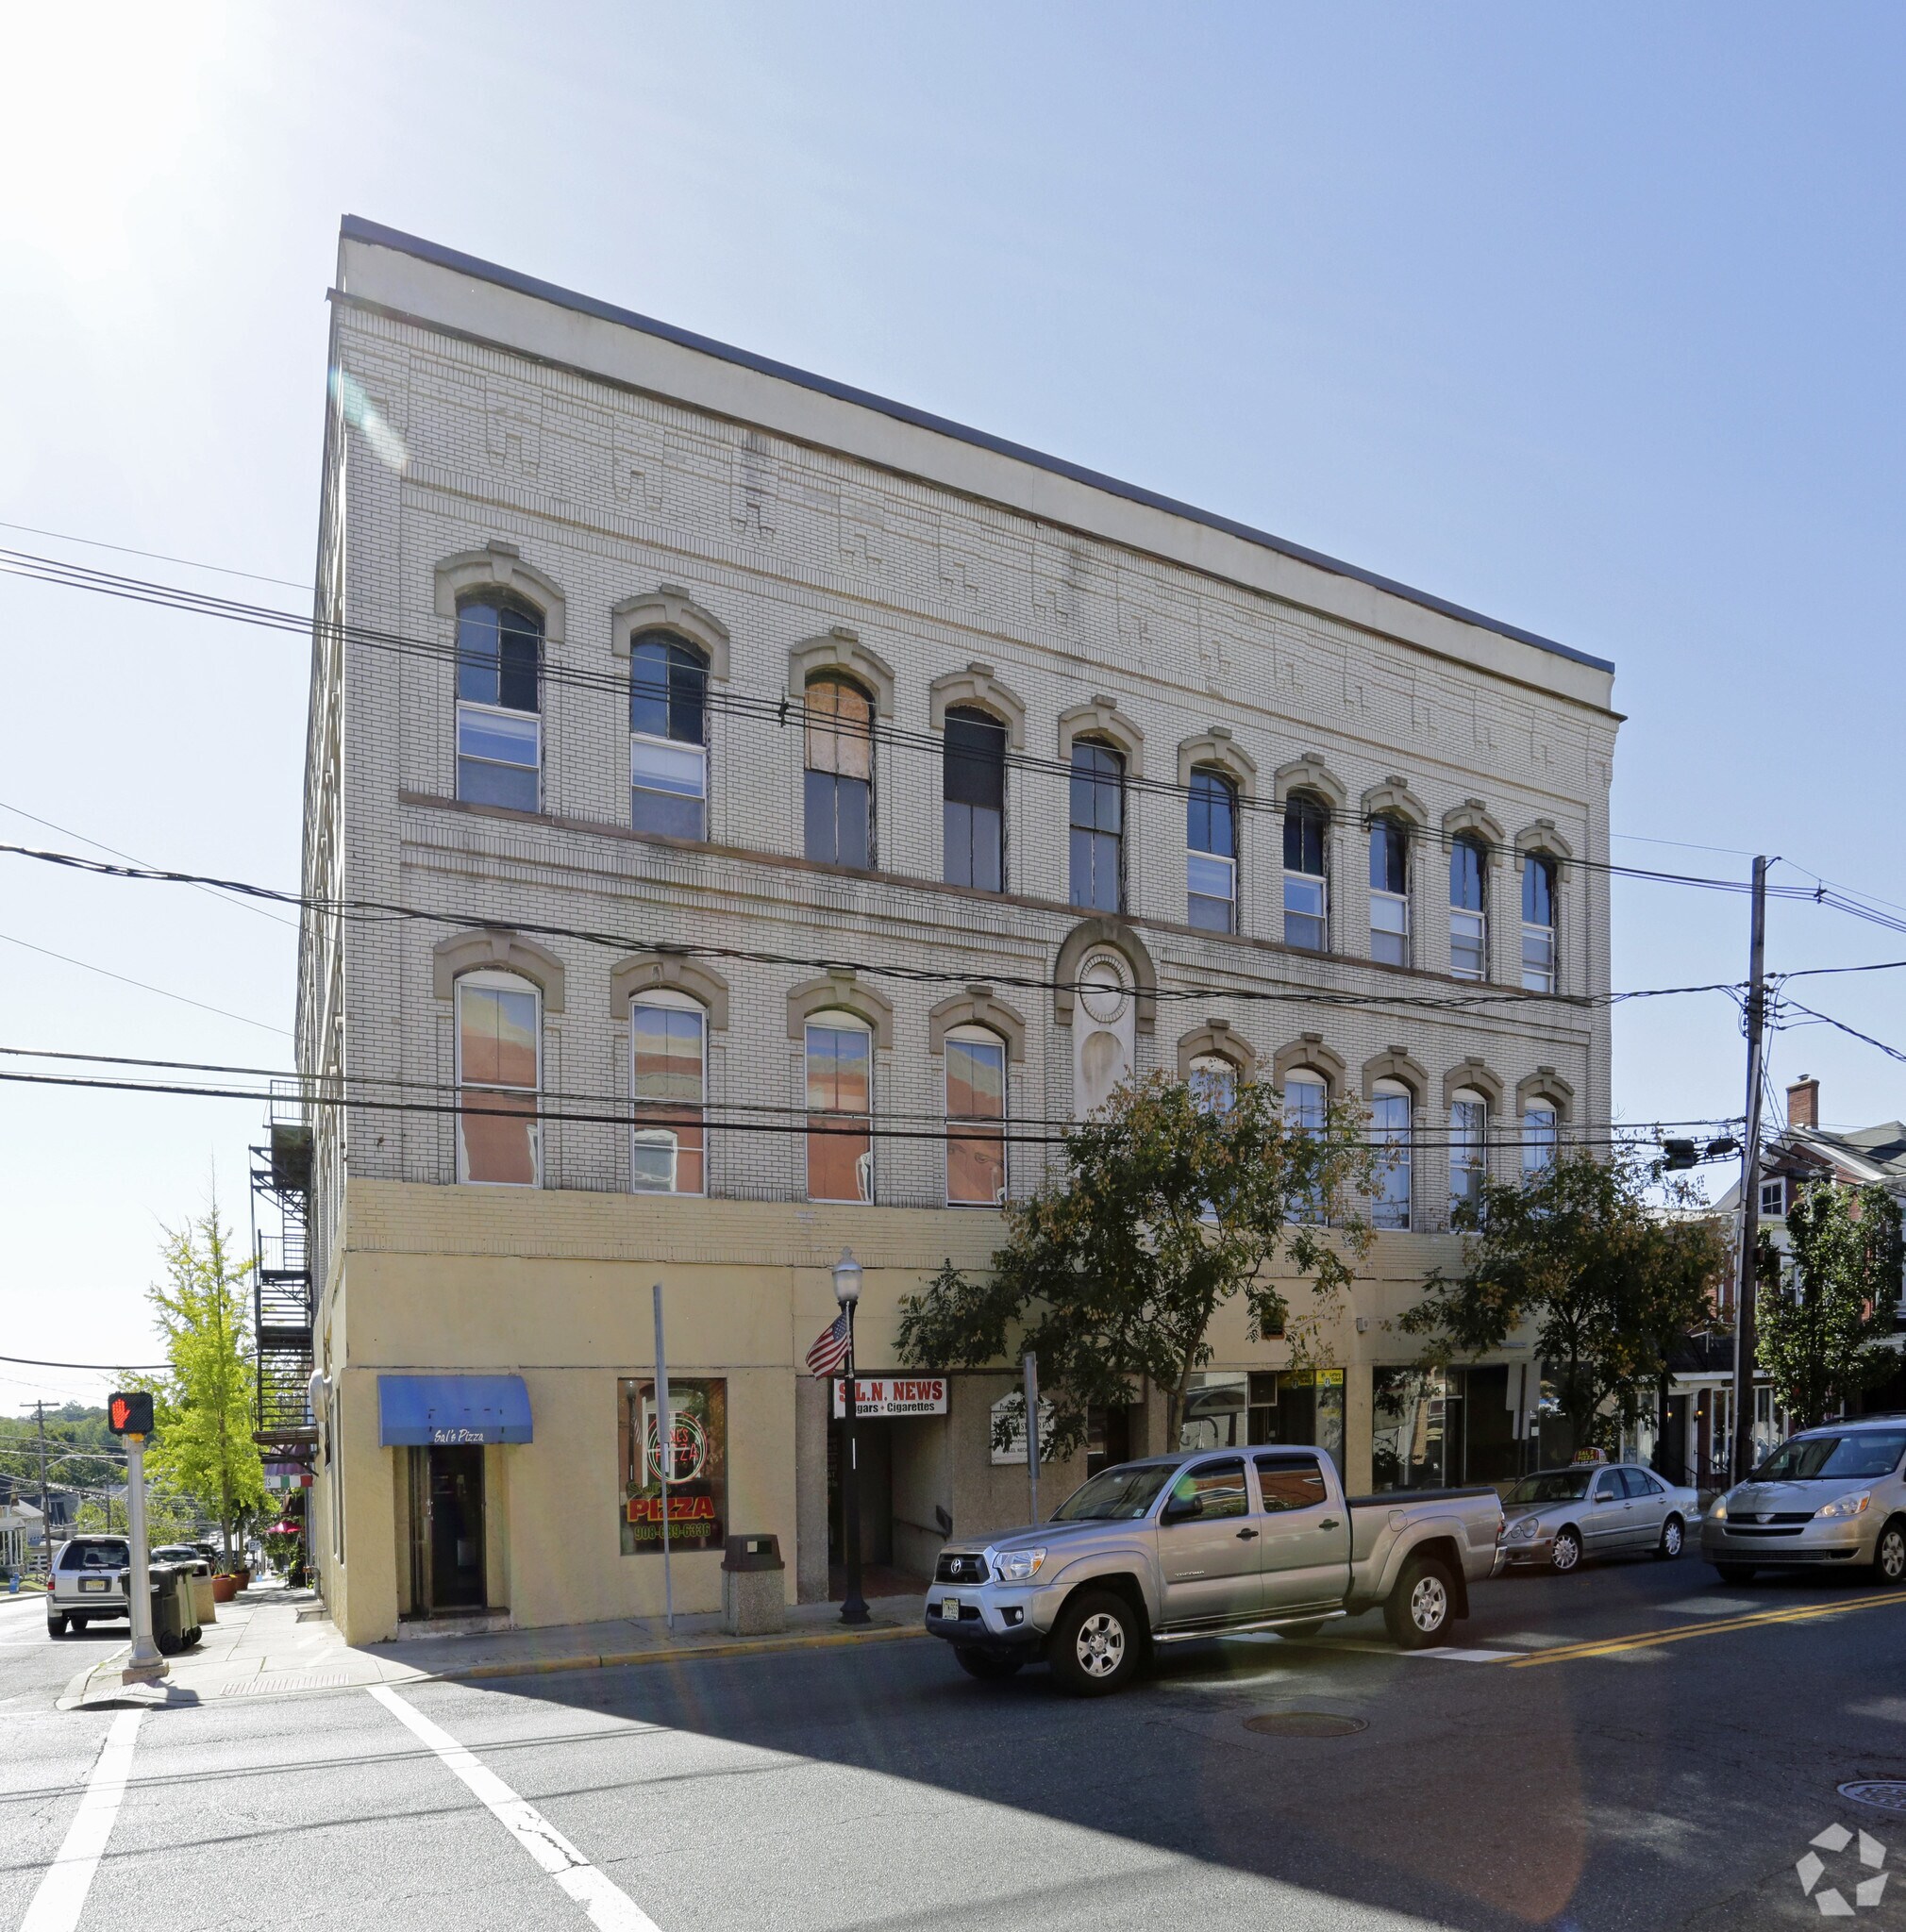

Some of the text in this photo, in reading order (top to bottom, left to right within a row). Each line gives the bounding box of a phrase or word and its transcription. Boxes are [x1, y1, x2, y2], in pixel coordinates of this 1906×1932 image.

[893, 1380, 944, 1402] NEWS
[887, 1402, 935, 1413] Cigarettes
[434, 1428, 484, 1443] Sal's Pizza
[655, 1442, 699, 1463] PZZA
[627, 1496, 716, 1523] PIZZA
